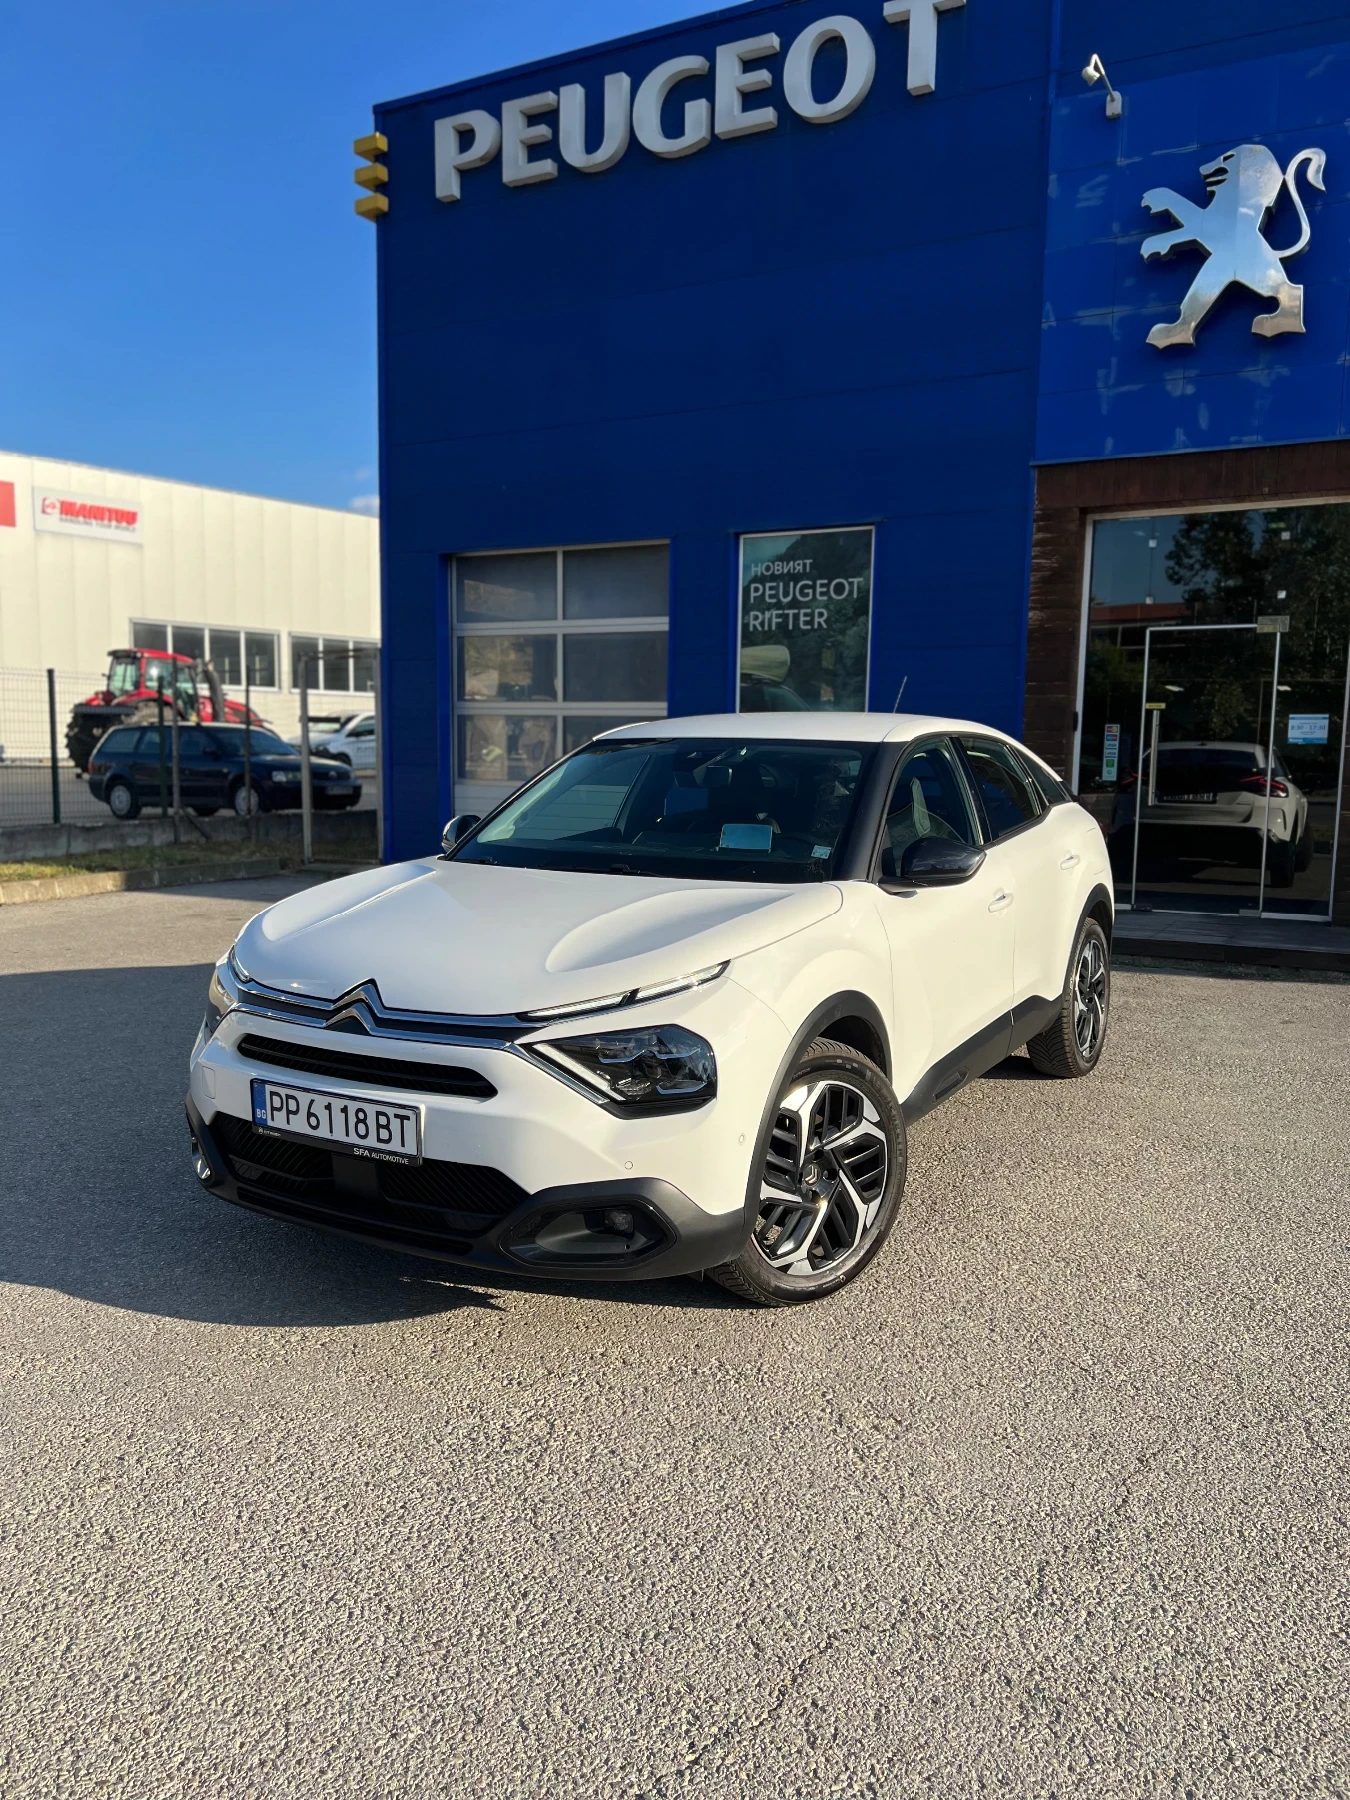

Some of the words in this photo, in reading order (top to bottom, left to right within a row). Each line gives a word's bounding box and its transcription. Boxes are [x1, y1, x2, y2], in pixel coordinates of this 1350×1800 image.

[434, 0, 967, 203] PEUGEOT
[59, 499, 138, 526] MANITOU
[751, 559, 813, 577] НОВИЯТ
[750, 577, 864, 604] PEUGEOT
[749, 608, 828, 632] RIFTER
[256, 1108, 267, 1119] BG
[353, 1147, 370, 1158] SFA
[371, 1152, 409, 1165] AUTOMOTIVE
